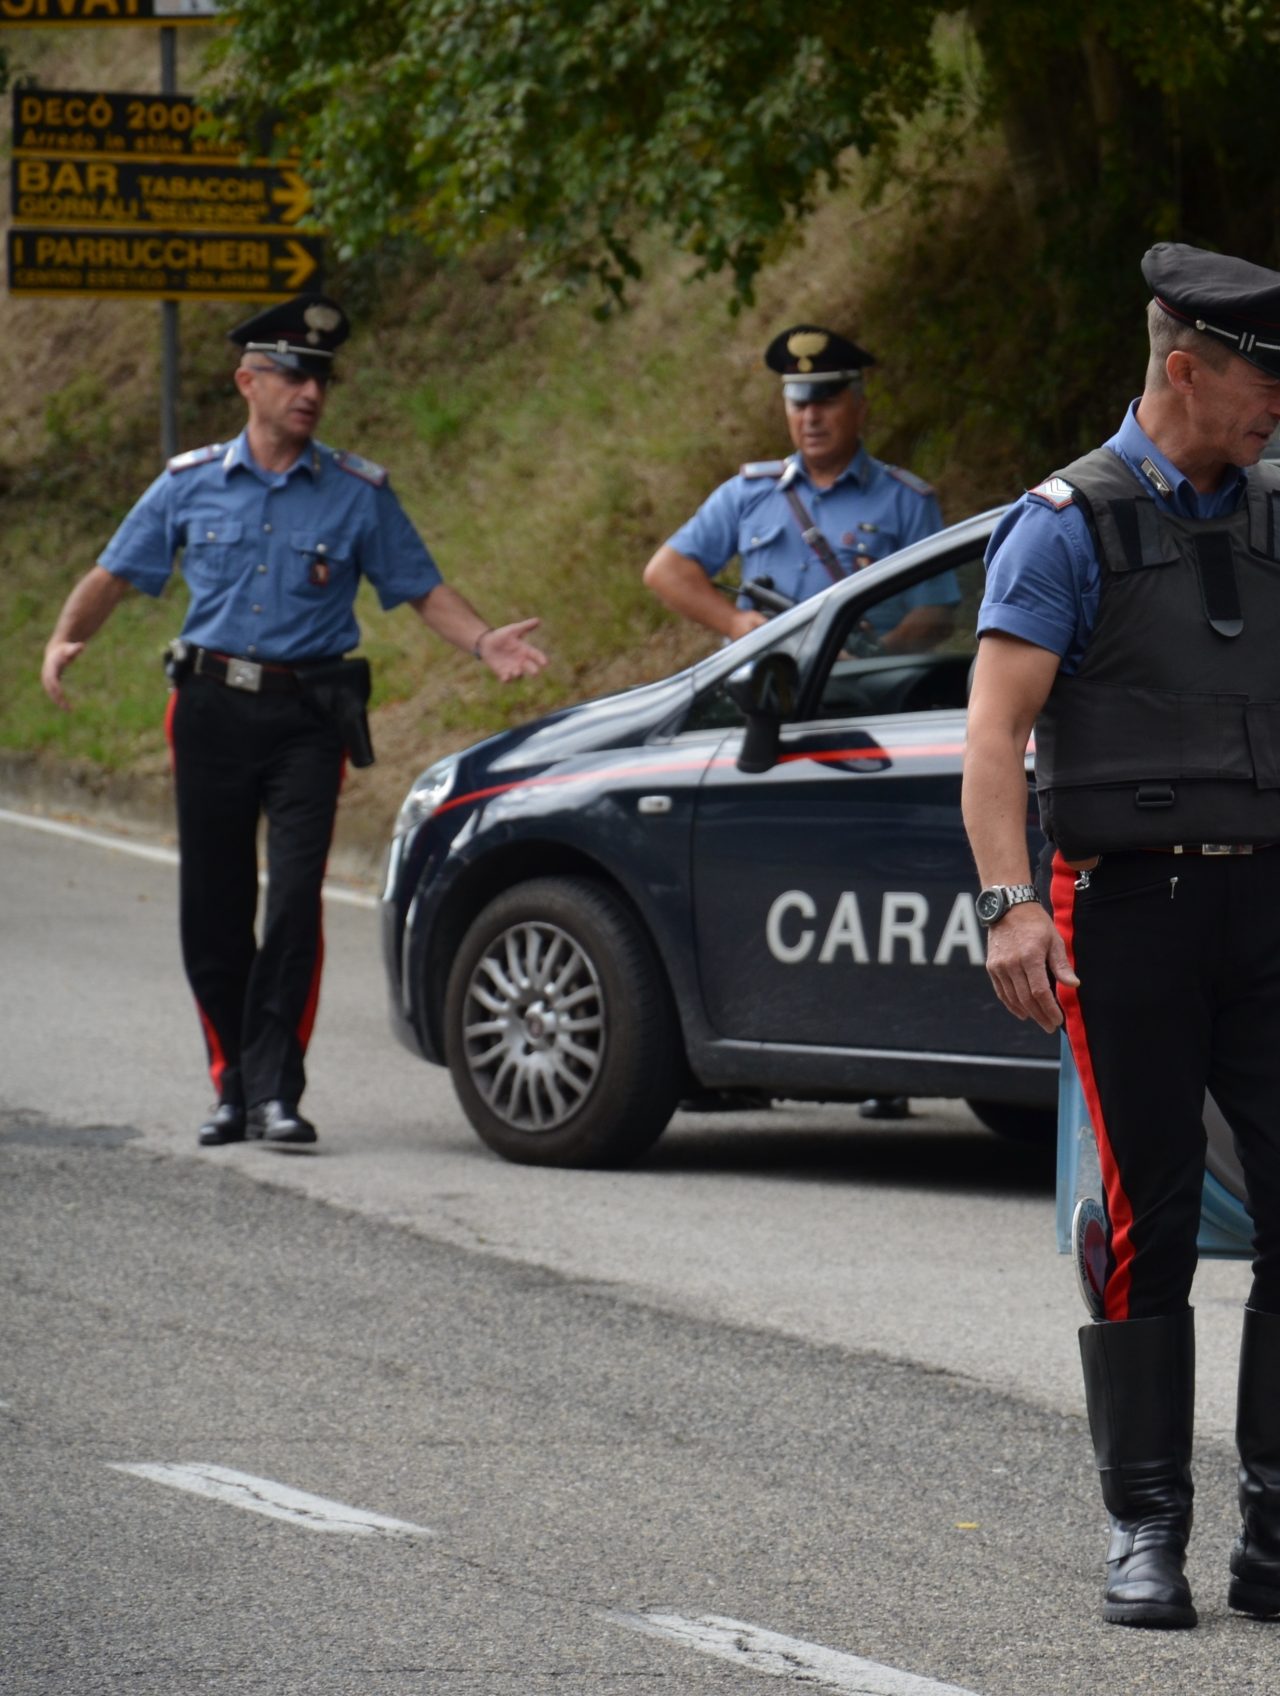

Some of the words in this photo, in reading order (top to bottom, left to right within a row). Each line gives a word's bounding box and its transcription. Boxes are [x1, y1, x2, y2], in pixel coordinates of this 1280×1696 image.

[18, 162, 118, 194] BAR
[138, 176, 265, 199] TABACCHI
[36, 239, 269, 269] PARRUCCHIERI
